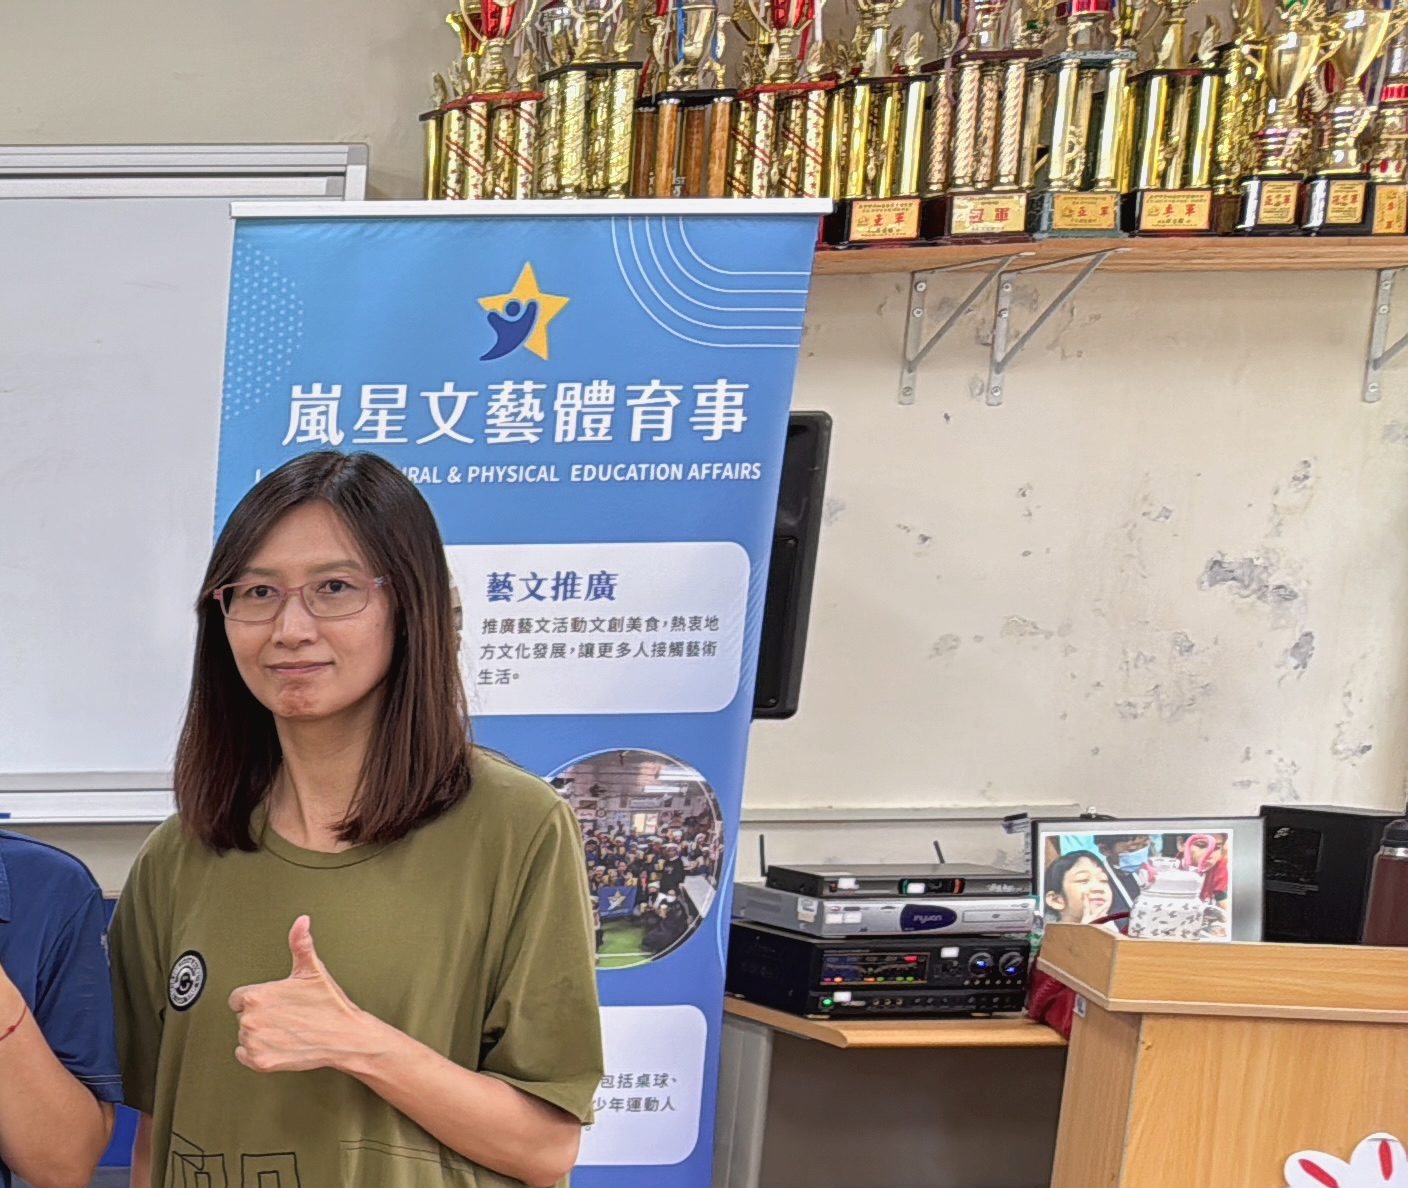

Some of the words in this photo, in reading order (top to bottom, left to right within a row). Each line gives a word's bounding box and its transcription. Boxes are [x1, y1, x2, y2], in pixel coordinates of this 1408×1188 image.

[281, 378, 751, 446] 嵐星文藝體育事
[447, 466, 462, 482] &
[467, 464, 559, 483] PHYSICAL
[570, 462, 683, 482] EDUCATION
[686, 462, 762, 480] AFFAIRS
[486, 570, 619, 602] 藝文推廣
